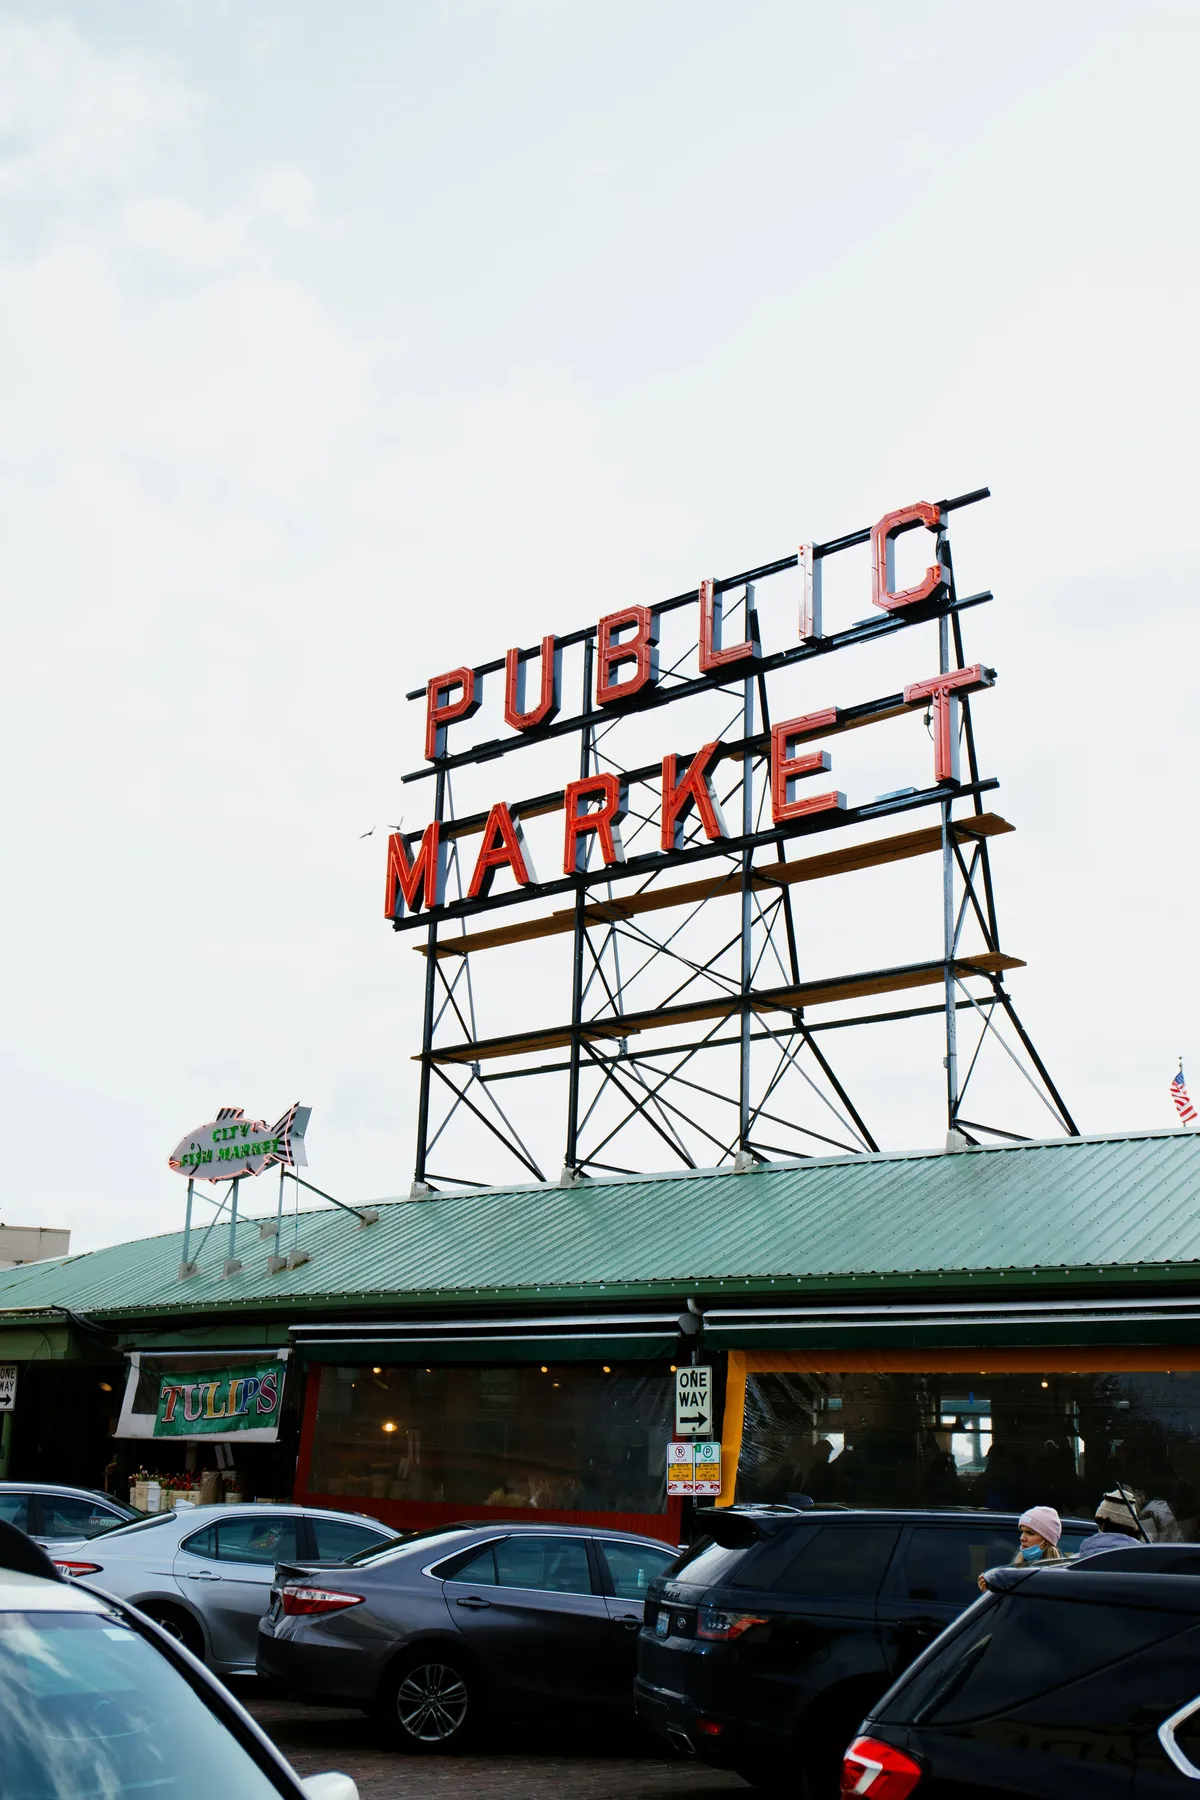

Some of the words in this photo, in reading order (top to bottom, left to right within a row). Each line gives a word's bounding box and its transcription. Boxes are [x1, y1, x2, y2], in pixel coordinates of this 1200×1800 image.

[425, 501, 950, 762] PUBLIC
[384, 664, 990, 919] MARKET
[212, 1123, 250, 1143] CITY
[181, 1149, 213, 1167] FISH
[218, 1138, 281, 1160] MARKET
[0, 1368, 15, 1379] ONE
[681, 1373, 706, 1388] ONE
[160, 1372, 279, 1423] TULIPS
[679, 1391, 708, 1407] WAY
